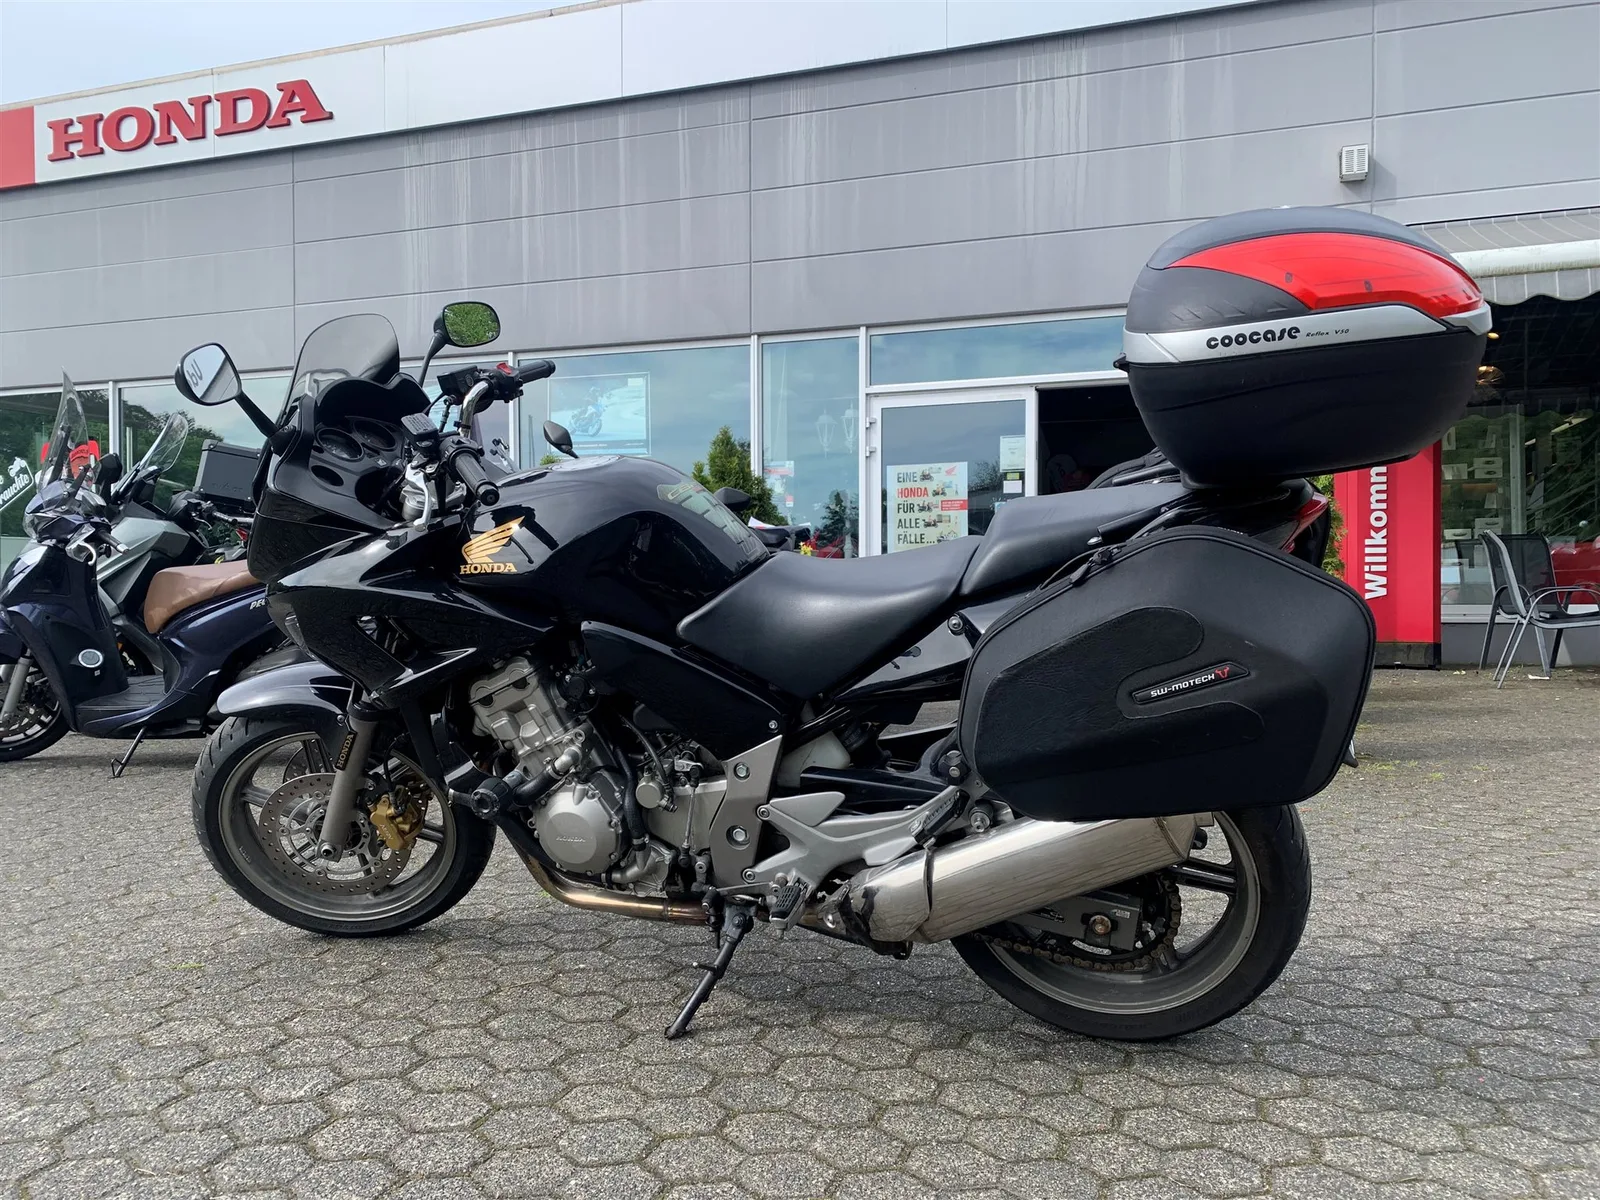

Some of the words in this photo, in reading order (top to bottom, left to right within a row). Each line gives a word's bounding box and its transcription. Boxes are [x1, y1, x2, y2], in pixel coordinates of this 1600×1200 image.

[47, 79, 333, 162] HONDA
[897, 472, 918, 483] EINE
[897, 487, 929, 498] HONDA
[897, 500, 915, 514] FÜR
[897, 518, 920, 529] ALLE
[460, 562, 518, 575] HONDA
[1150, 673, 1215, 698] SW-MOTECH
[337, 734, 354, 768] HONDA
